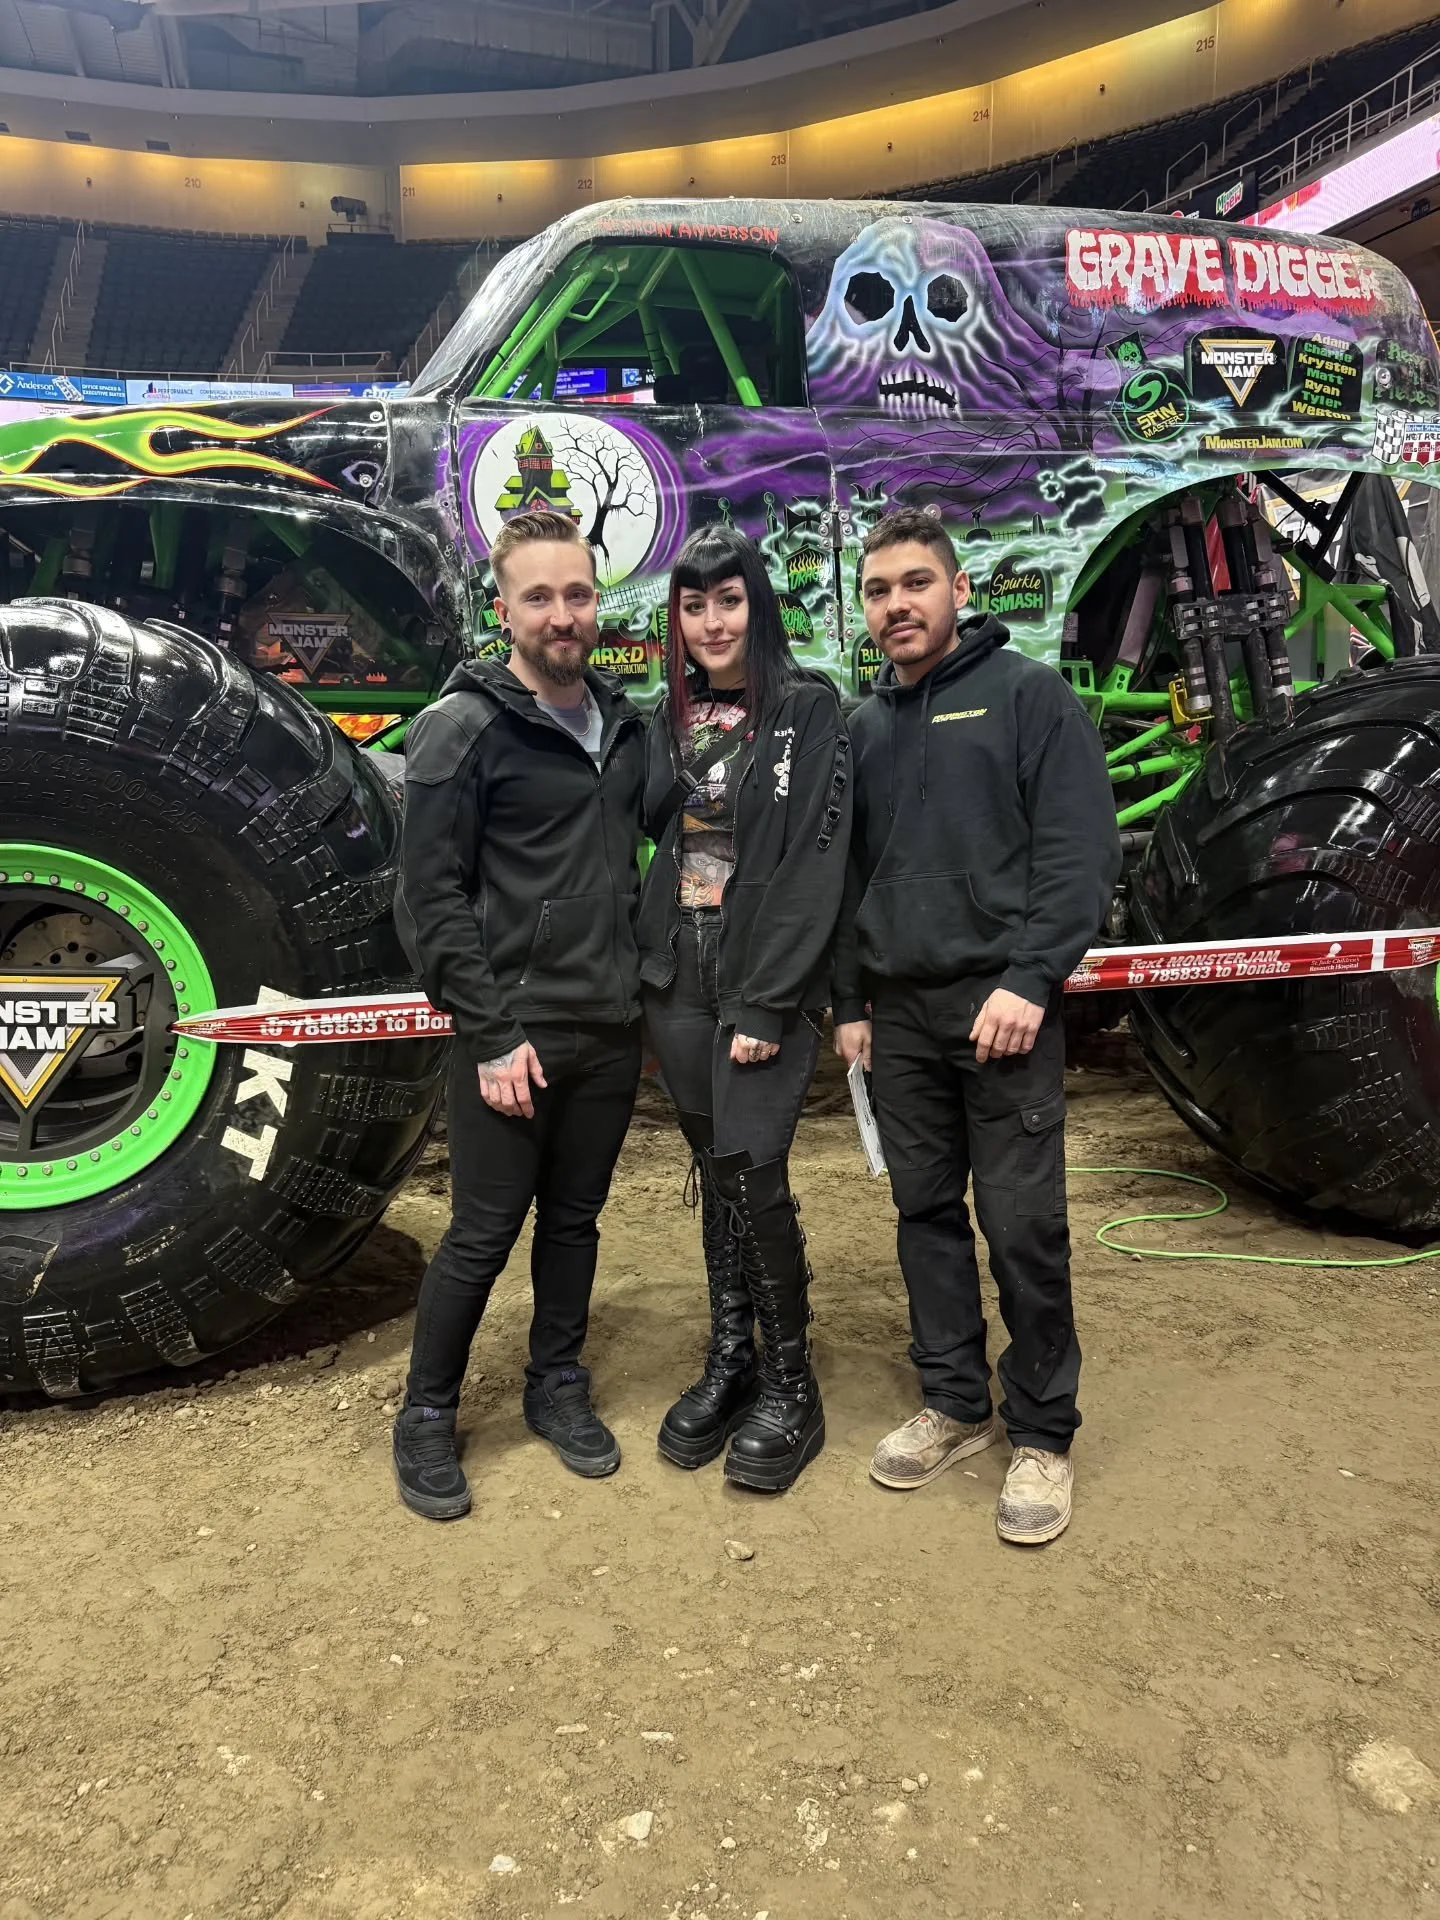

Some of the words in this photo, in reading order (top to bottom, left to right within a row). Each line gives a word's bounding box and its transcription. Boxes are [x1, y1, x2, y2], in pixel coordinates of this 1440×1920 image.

[1196, 35, 1215, 53] 215
[973, 108, 990, 123] 214
[771, 154, 787, 166] 213
[184, 176, 201, 189] 210
[402, 186, 416, 197] 211
[577, 178, 593, 190] 212
[678, 223, 780, 244] ANDERSON
[1067, 229, 1225, 293] GRAVE
[1311, 332, 1350, 350] Adam
[1201, 352, 1275, 365] MONSTER
[1303, 342, 1353, 363] Charlie
[1222, 365, 1257, 378] JAM
[1298, 353, 1357, 377] Krysten
[17, 380, 54, 391] Anderson
[1306, 368, 1344, 385] Matt
[1304, 379, 1341, 397] Ryan
[1302, 391, 1343, 409] Tyler
[1136, 402, 1178, 430] SPIN
[1292, 401, 1351, 421] Weston
[1143, 414, 1184, 439] MASTER
[992, 574, 1041, 595] Sparkle
[990, 592, 1044, 615] SMASH
[268, 623, 348, 637] MONSTER
[292, 636, 329, 648] JAM
[1130, 958, 1163, 971] Text
[1166, 950, 1281, 968] MONSTERJAM
[1335, 962, 1359, 971] Hospital
[1127, 970, 1144, 984] to
[1150, 966, 1211, 983] 785833
[1216, 964, 1232, 978] to
[1236, 961, 1290, 977] Donate
[290, 1017, 378, 1036] 785833
[386, 1016, 408, 1032] to
